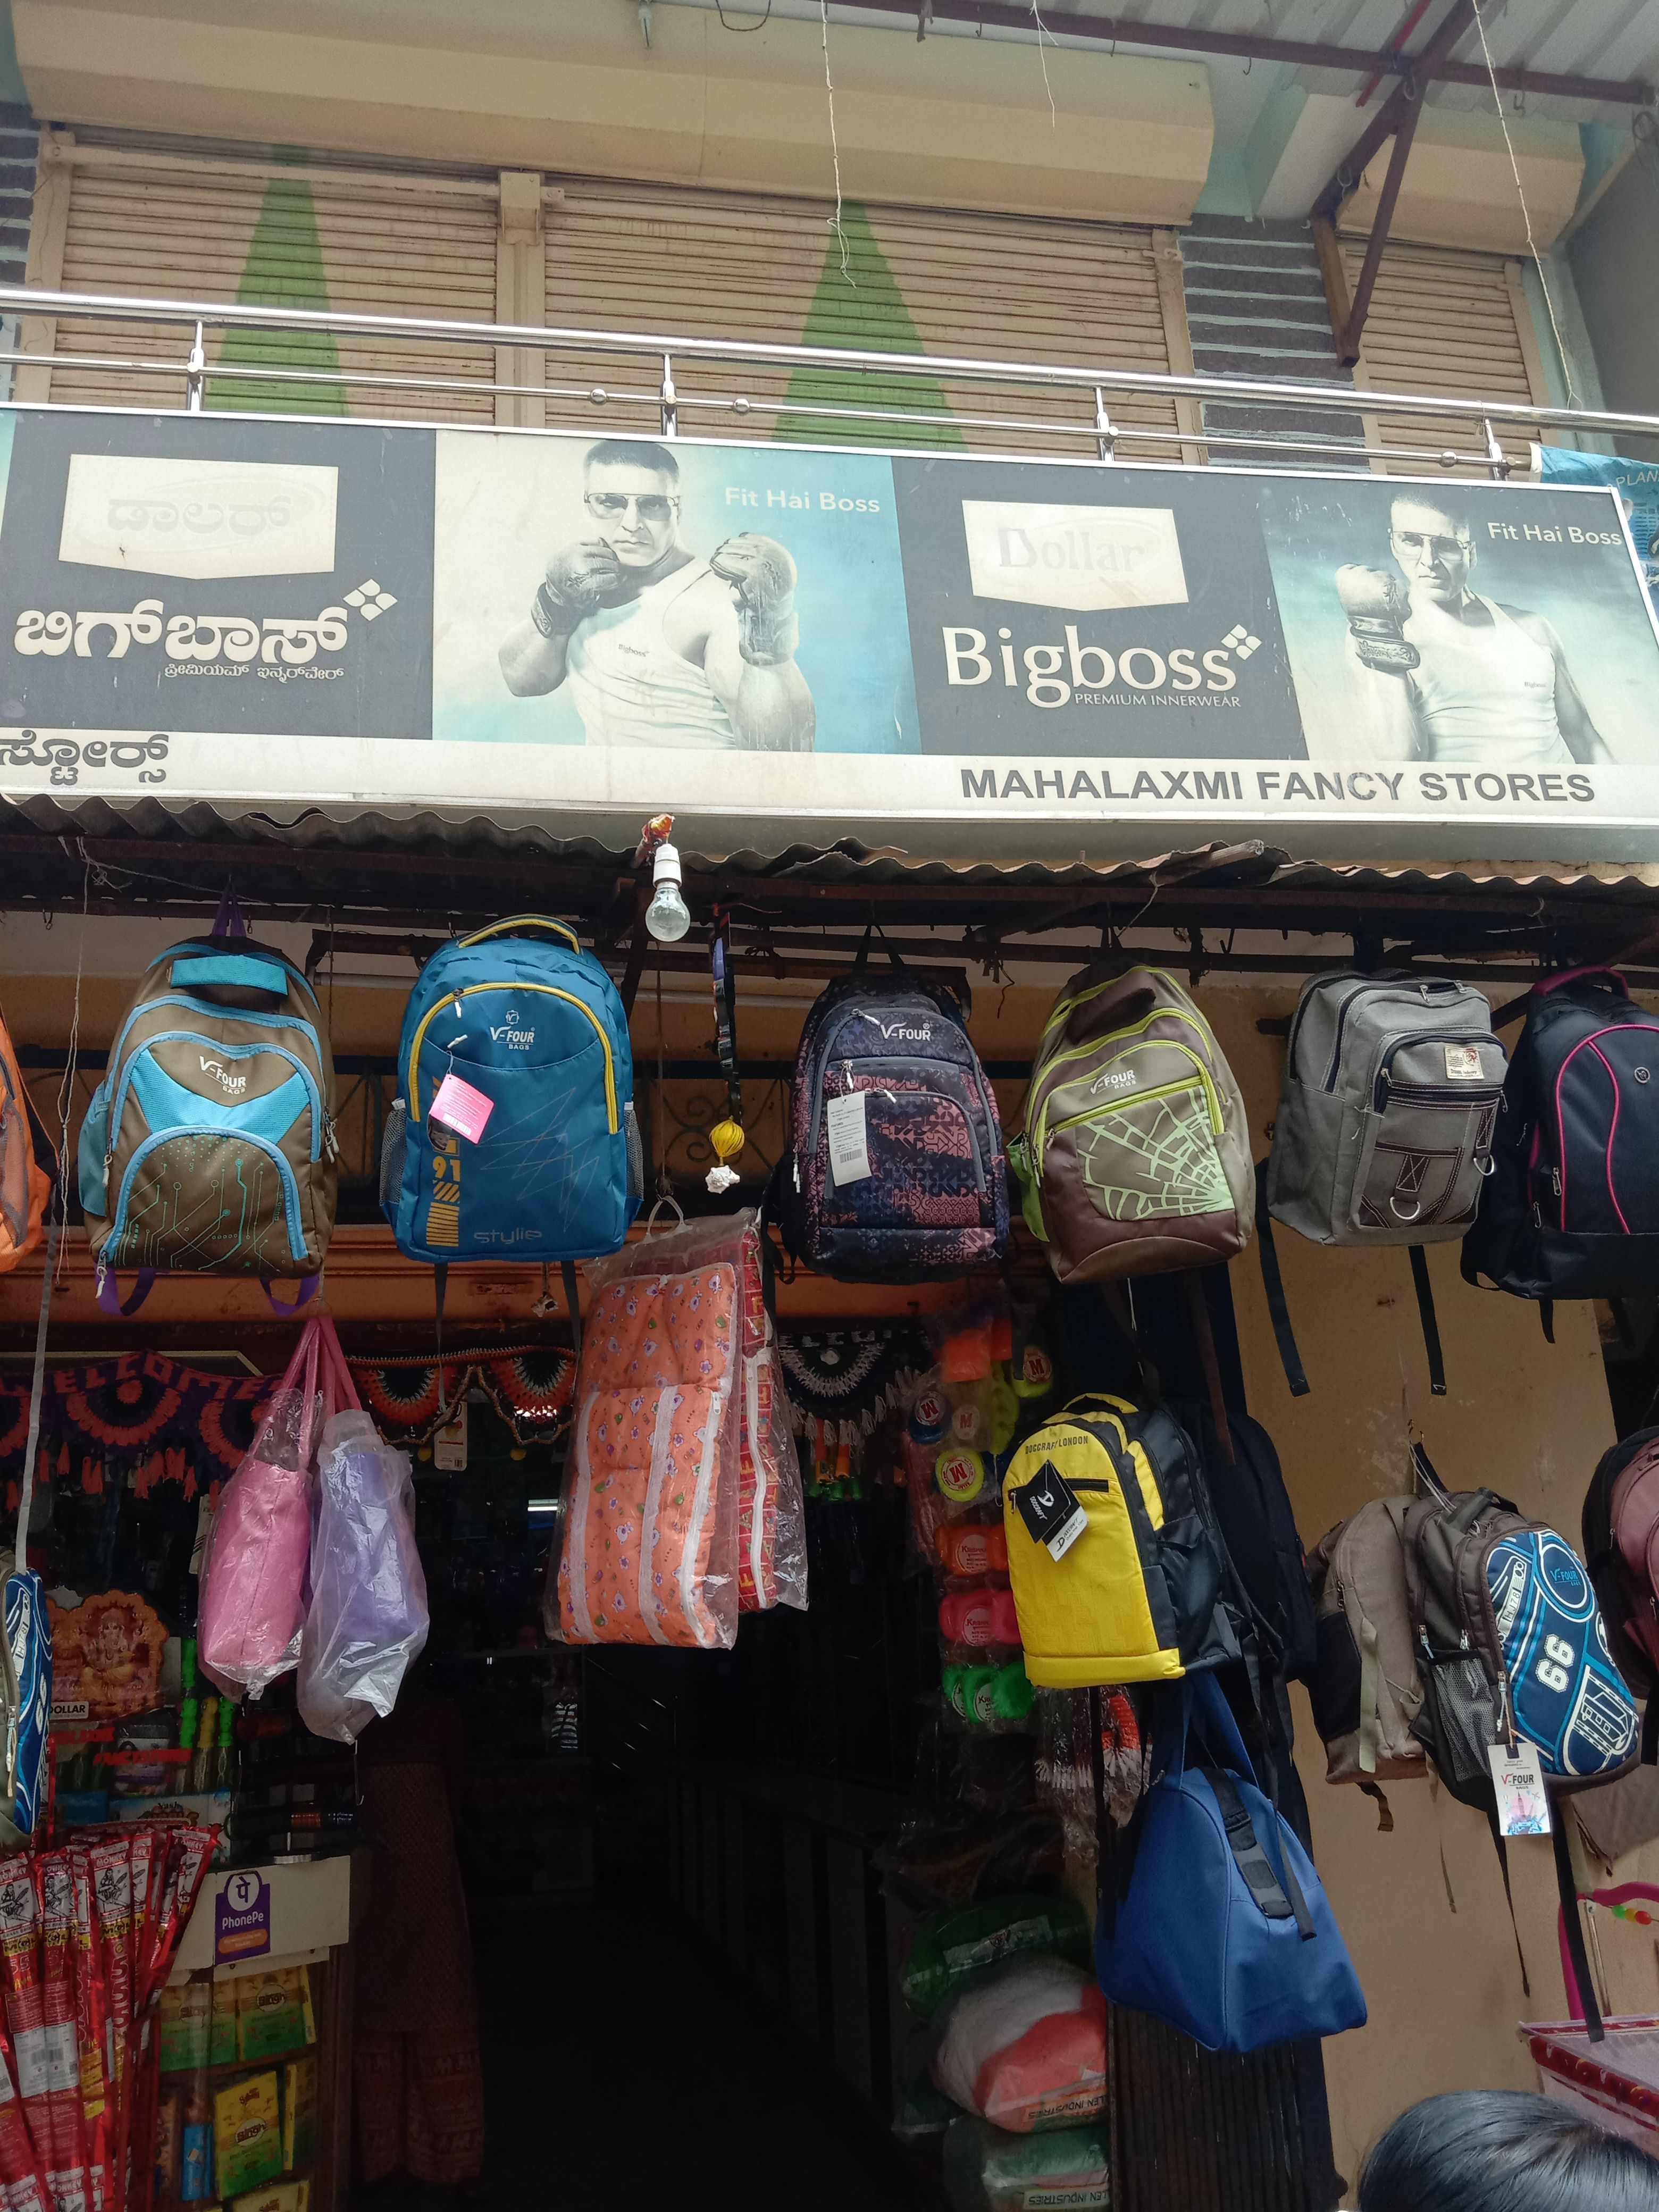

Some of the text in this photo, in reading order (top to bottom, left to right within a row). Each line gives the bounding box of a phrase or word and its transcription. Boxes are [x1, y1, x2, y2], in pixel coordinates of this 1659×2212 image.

[725, 487, 880, 513] Fit Hai Boss
[1487, 522, 1519, 540] Fit
[1523, 524, 1563, 542] Hai
[1568, 526, 1622, 545] Boss
[998, 527, 1146, 572] Dollar
[942, 625, 1237, 708] Bigboss
[1075, 693, 1241, 708] PREMIUM INNERWEAR
[961, 769, 1595, 801] MAHALAXMI FANCY STORES
[222, 1085, 246, 1095] BAGS
[1114, 1080, 1136, 1090] BAGS
[1058, 1436, 1088, 1447] LONDON
[236, 1875, 250, 1904] पे
[222, 1911, 264, 1930] PhonePe
[1028, 2193, 1086, 2206] INDUSTRIES
